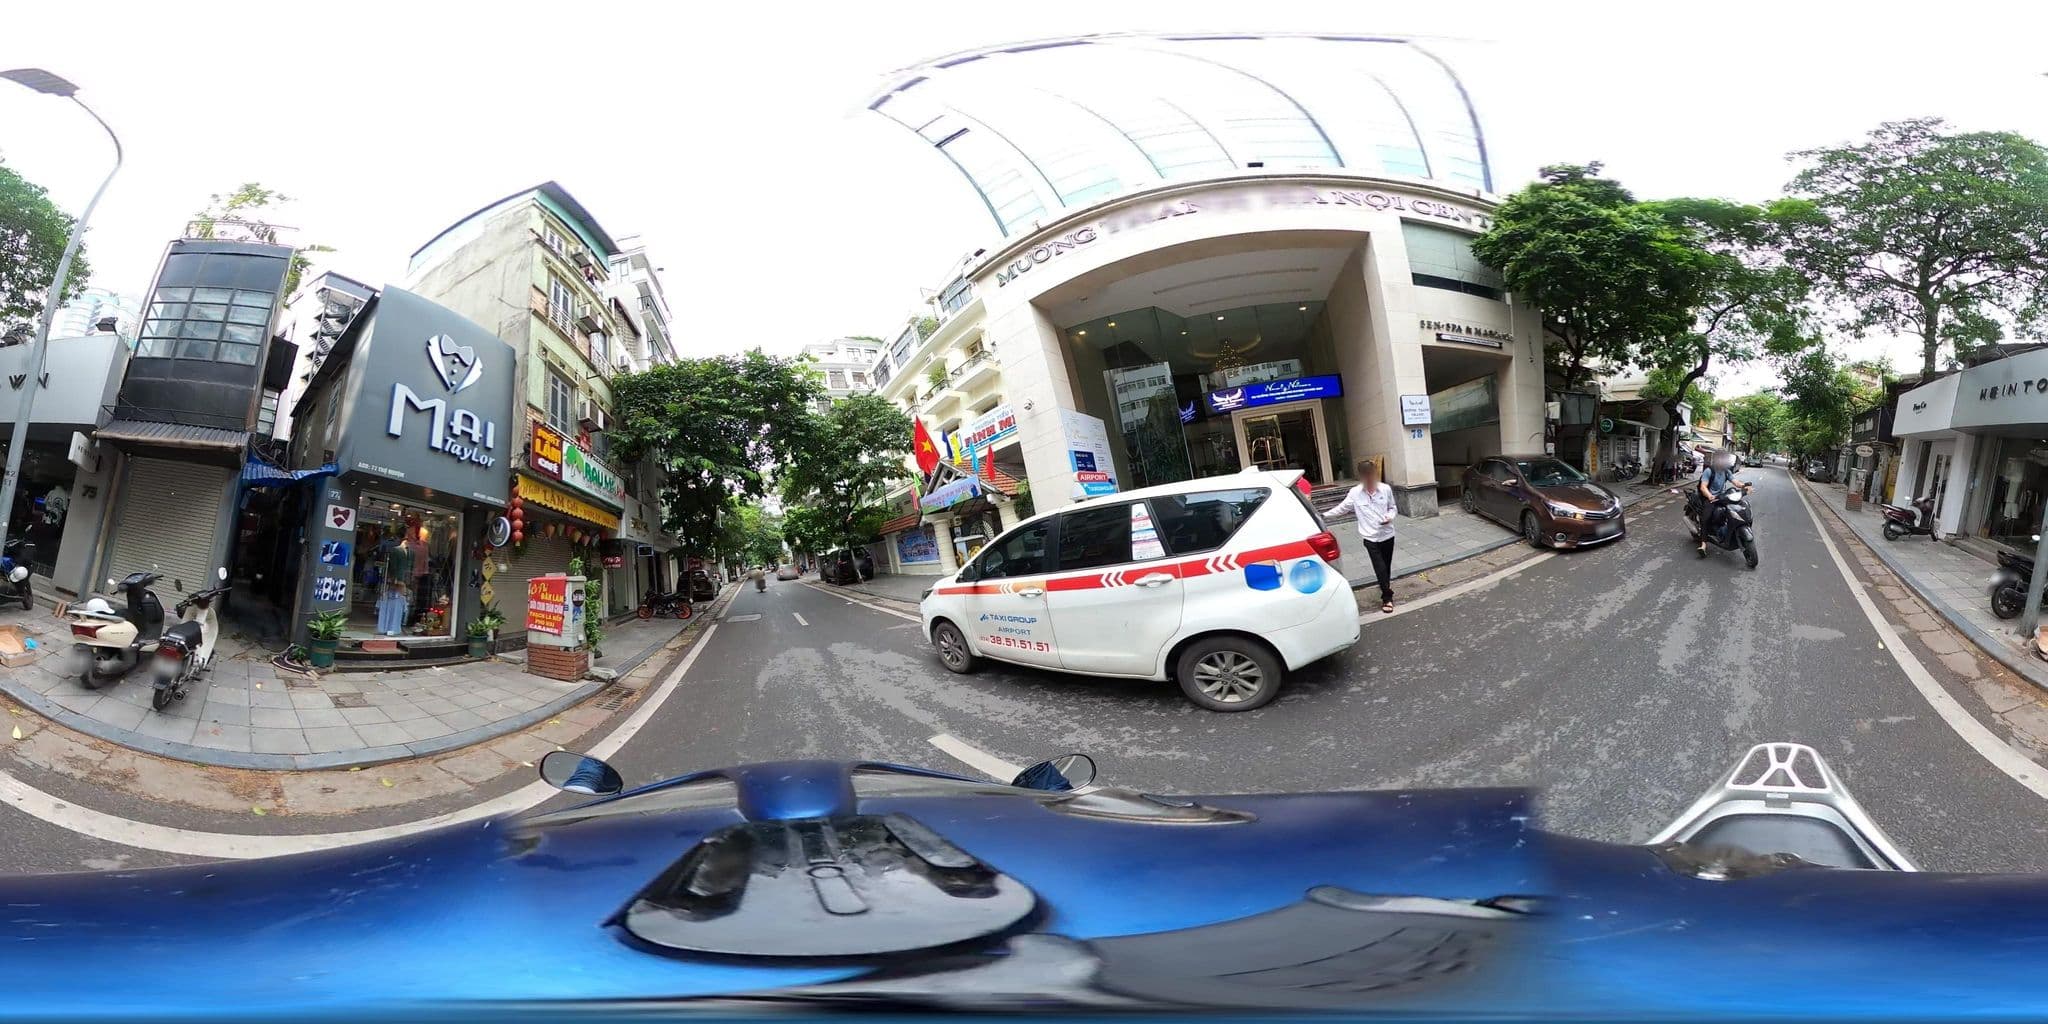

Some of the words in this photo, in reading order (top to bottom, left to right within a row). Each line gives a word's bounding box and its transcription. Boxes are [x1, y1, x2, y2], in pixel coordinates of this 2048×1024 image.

[387, 382, 495, 450] MAI
[1410, 427, 1424, 440] 78
[1080, 474, 1107, 482] AIRPORT
[998, 626, 1031, 636] AIRPORT
[989, 634, 1051, 653] 38.51.51.51
